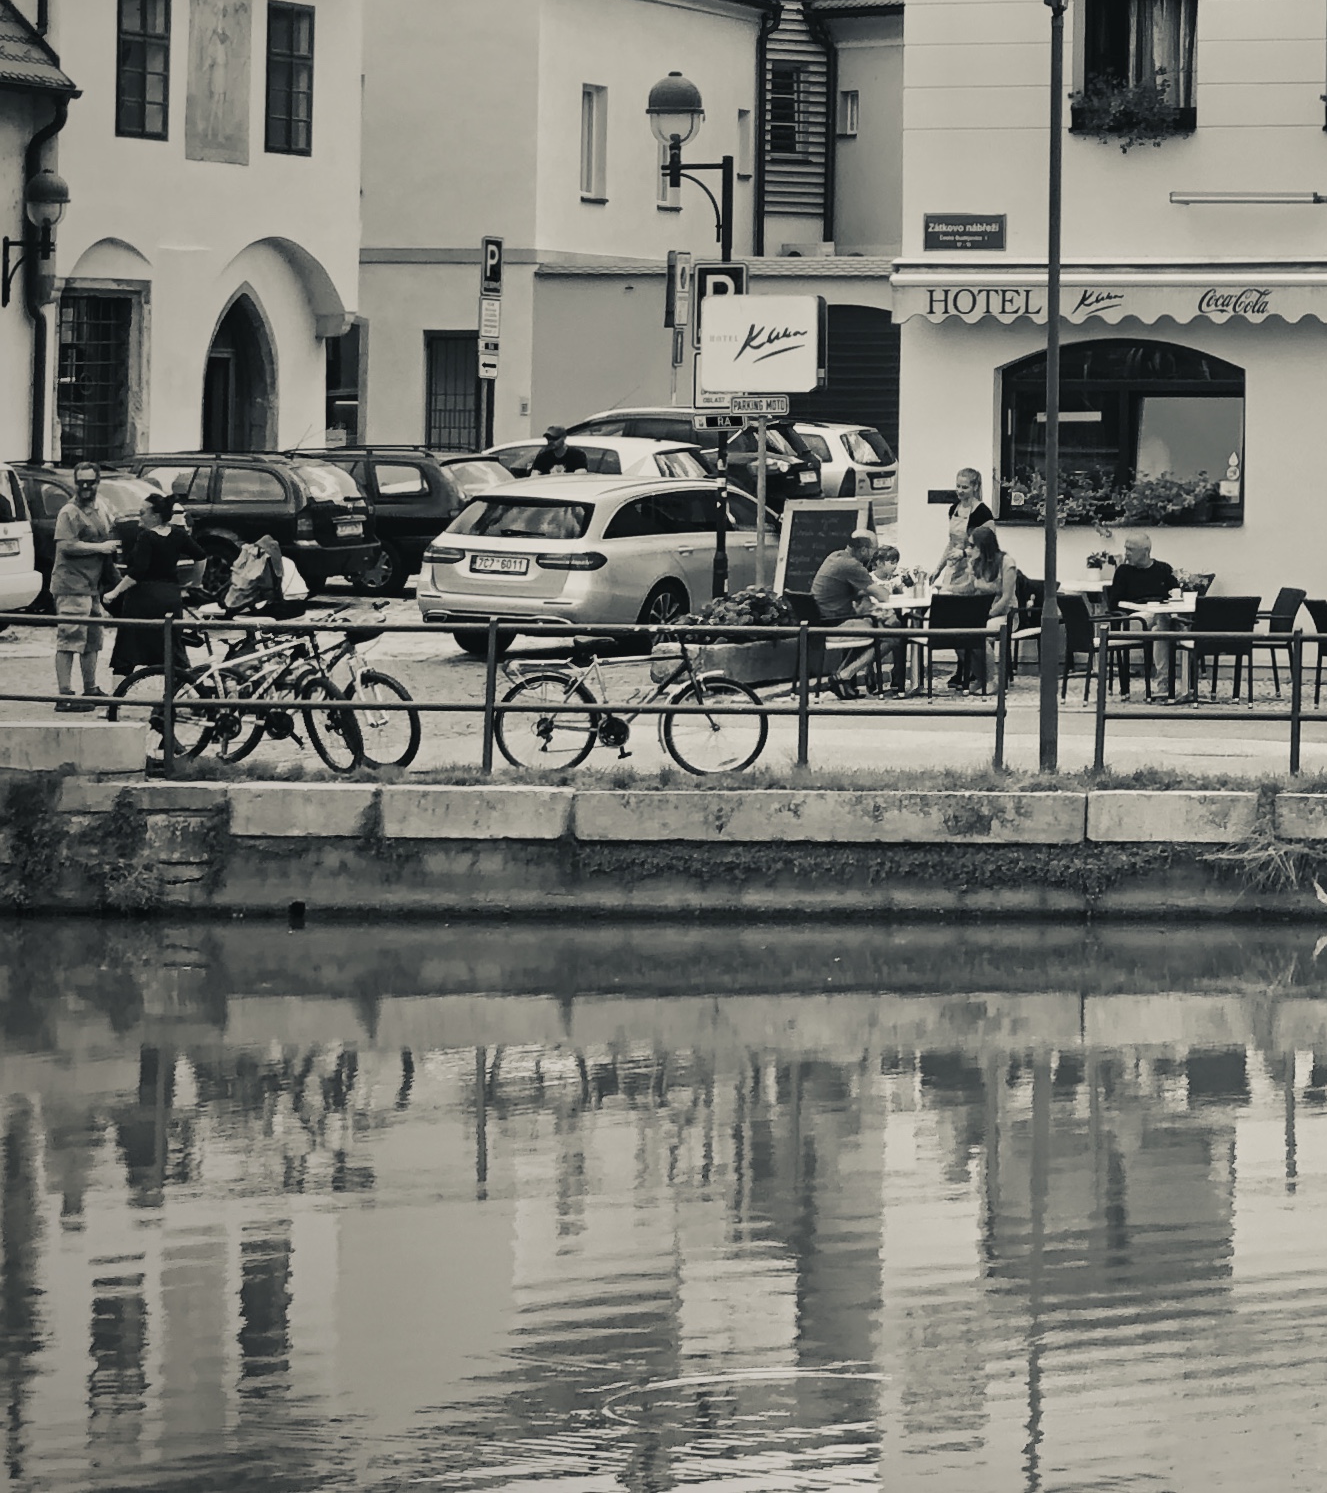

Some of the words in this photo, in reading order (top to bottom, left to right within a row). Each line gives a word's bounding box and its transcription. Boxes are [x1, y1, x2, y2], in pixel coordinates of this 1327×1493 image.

[927, 222, 964, 232] Zátkovo
[965, 222, 999, 232] nábřeží
[486, 244, 499, 277] P
[926, 288, 1043, 315] HOTEL
[733, 399, 764, 411] PARKING
[765, 399, 785, 411] MOTO
